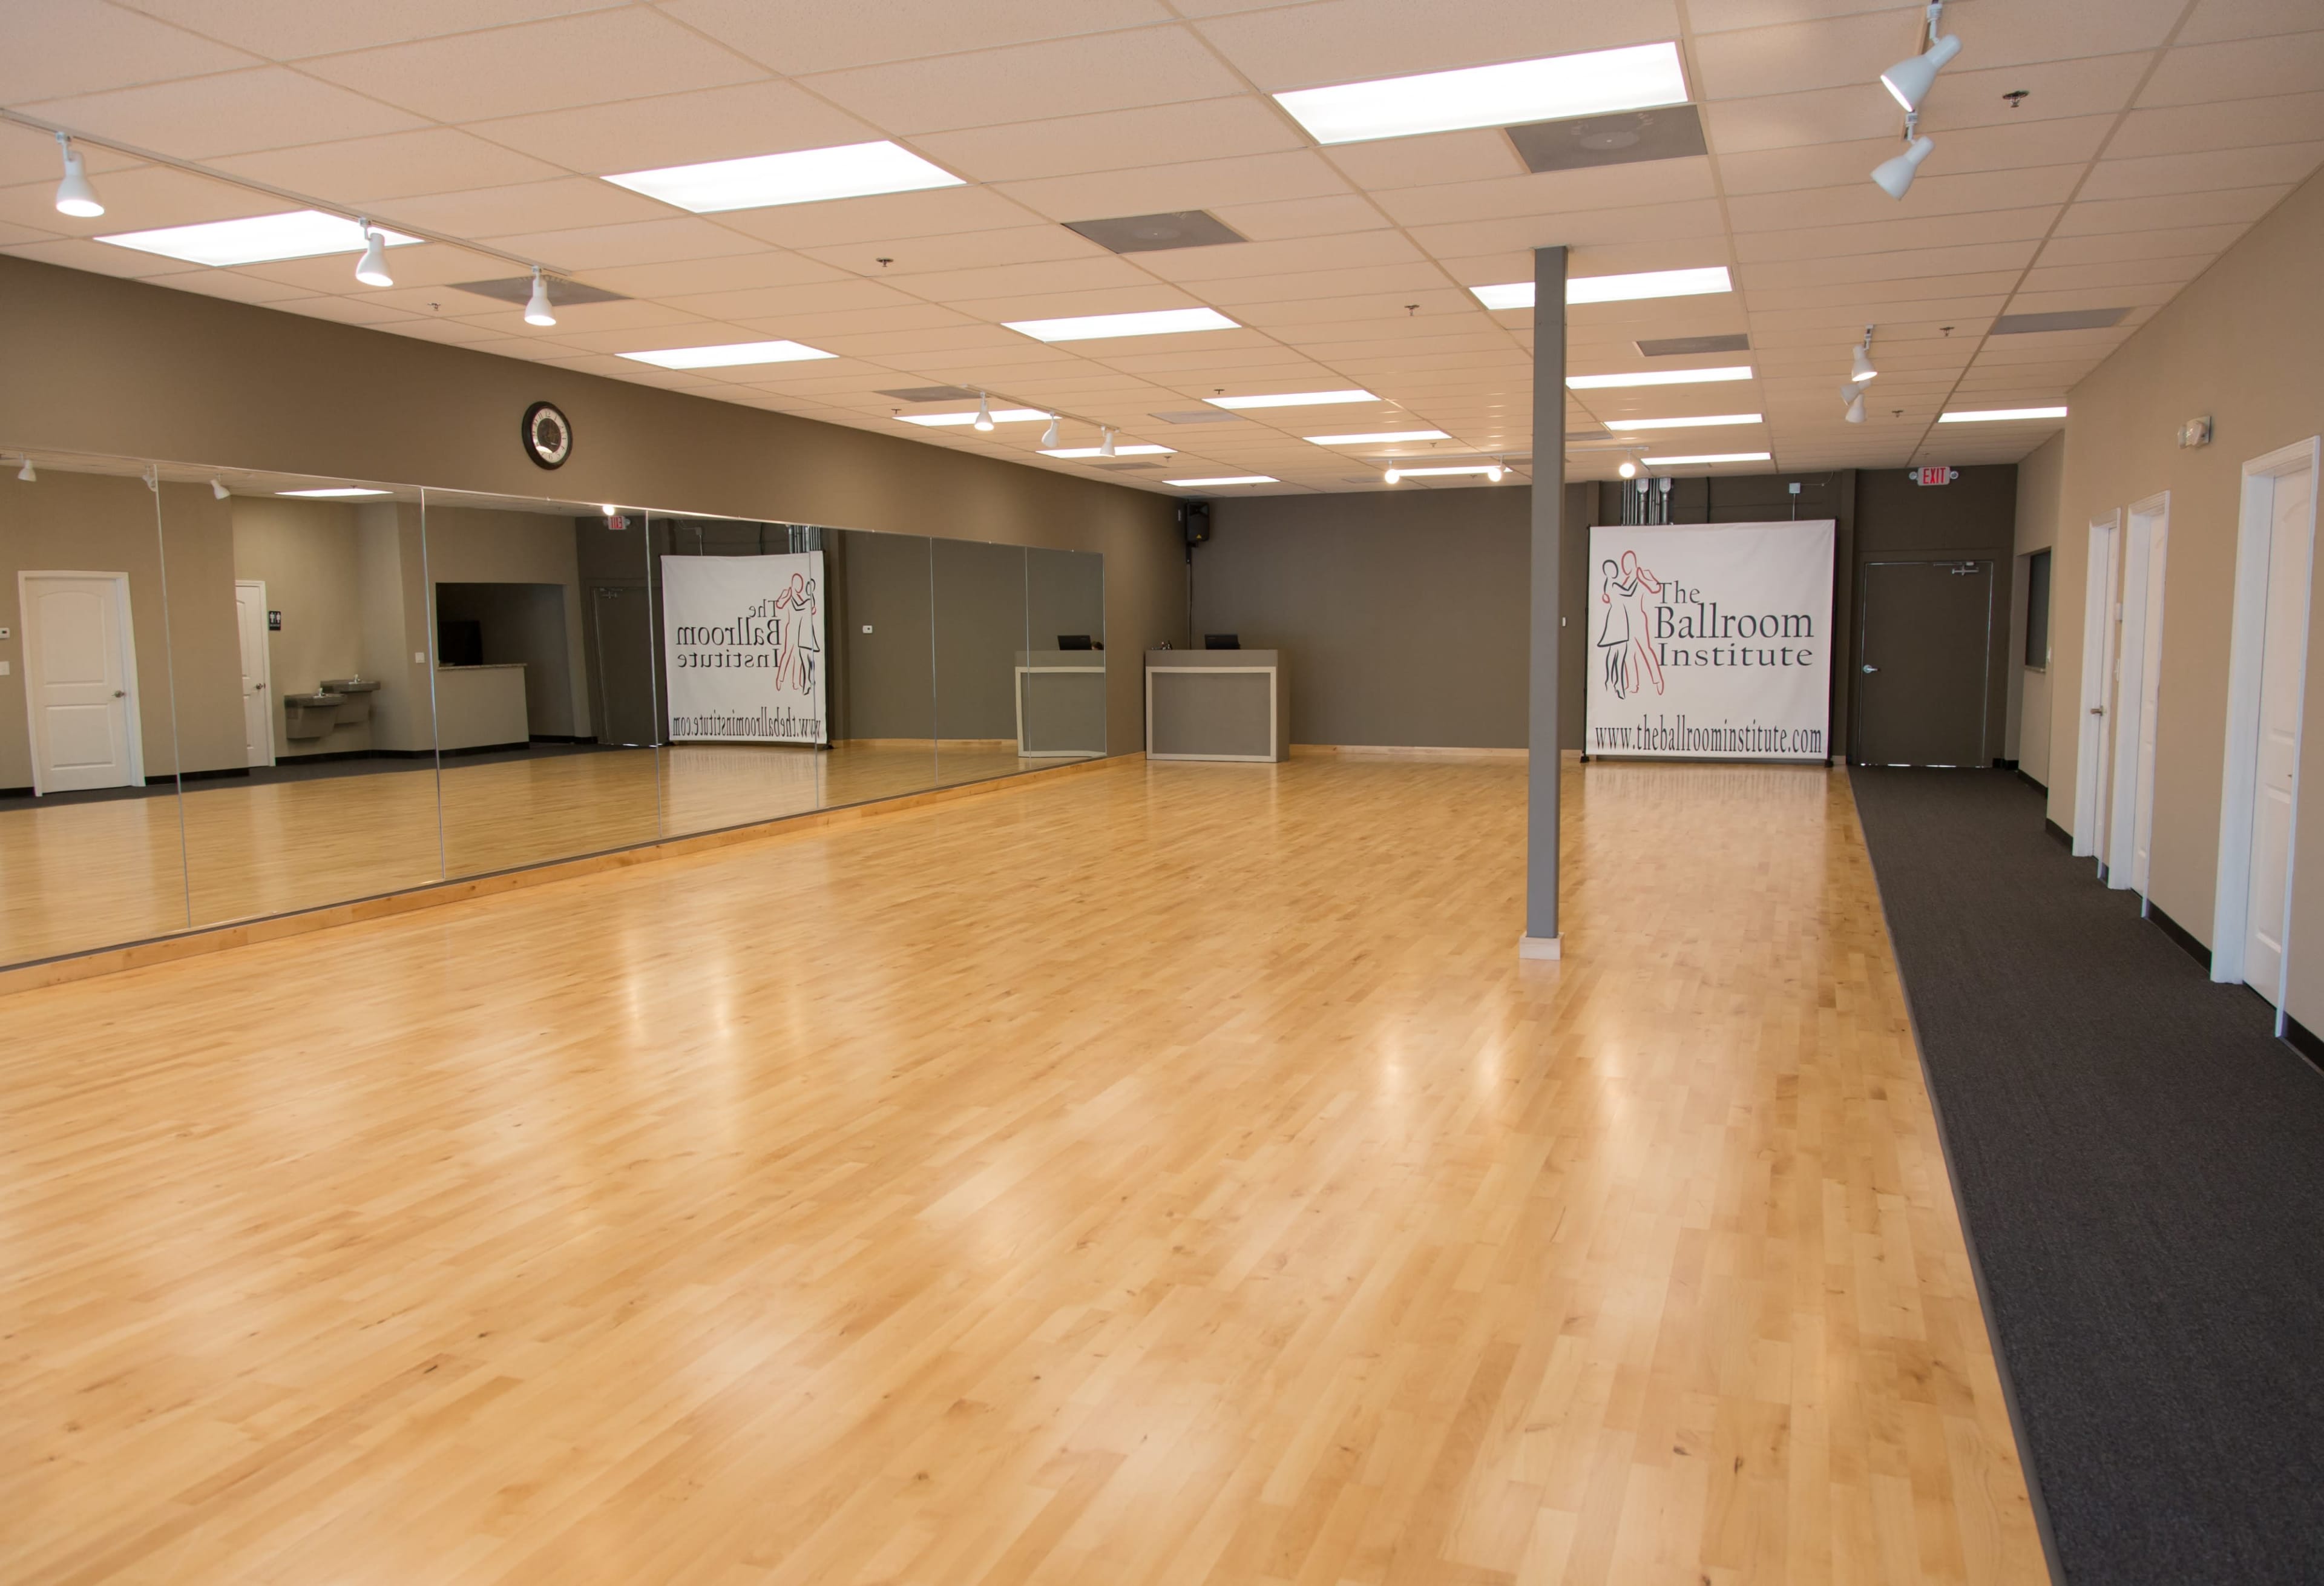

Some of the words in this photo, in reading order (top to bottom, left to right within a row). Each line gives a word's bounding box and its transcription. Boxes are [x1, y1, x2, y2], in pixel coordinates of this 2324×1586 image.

[1923, 467, 1946, 484] EXIT
[1657, 580, 1700, 604] The
[1655, 602, 1814, 638] Ballroom
[1658, 642, 1813, 666] Institute
[1595, 714, 1822, 753] www.theballroominstitute.com
